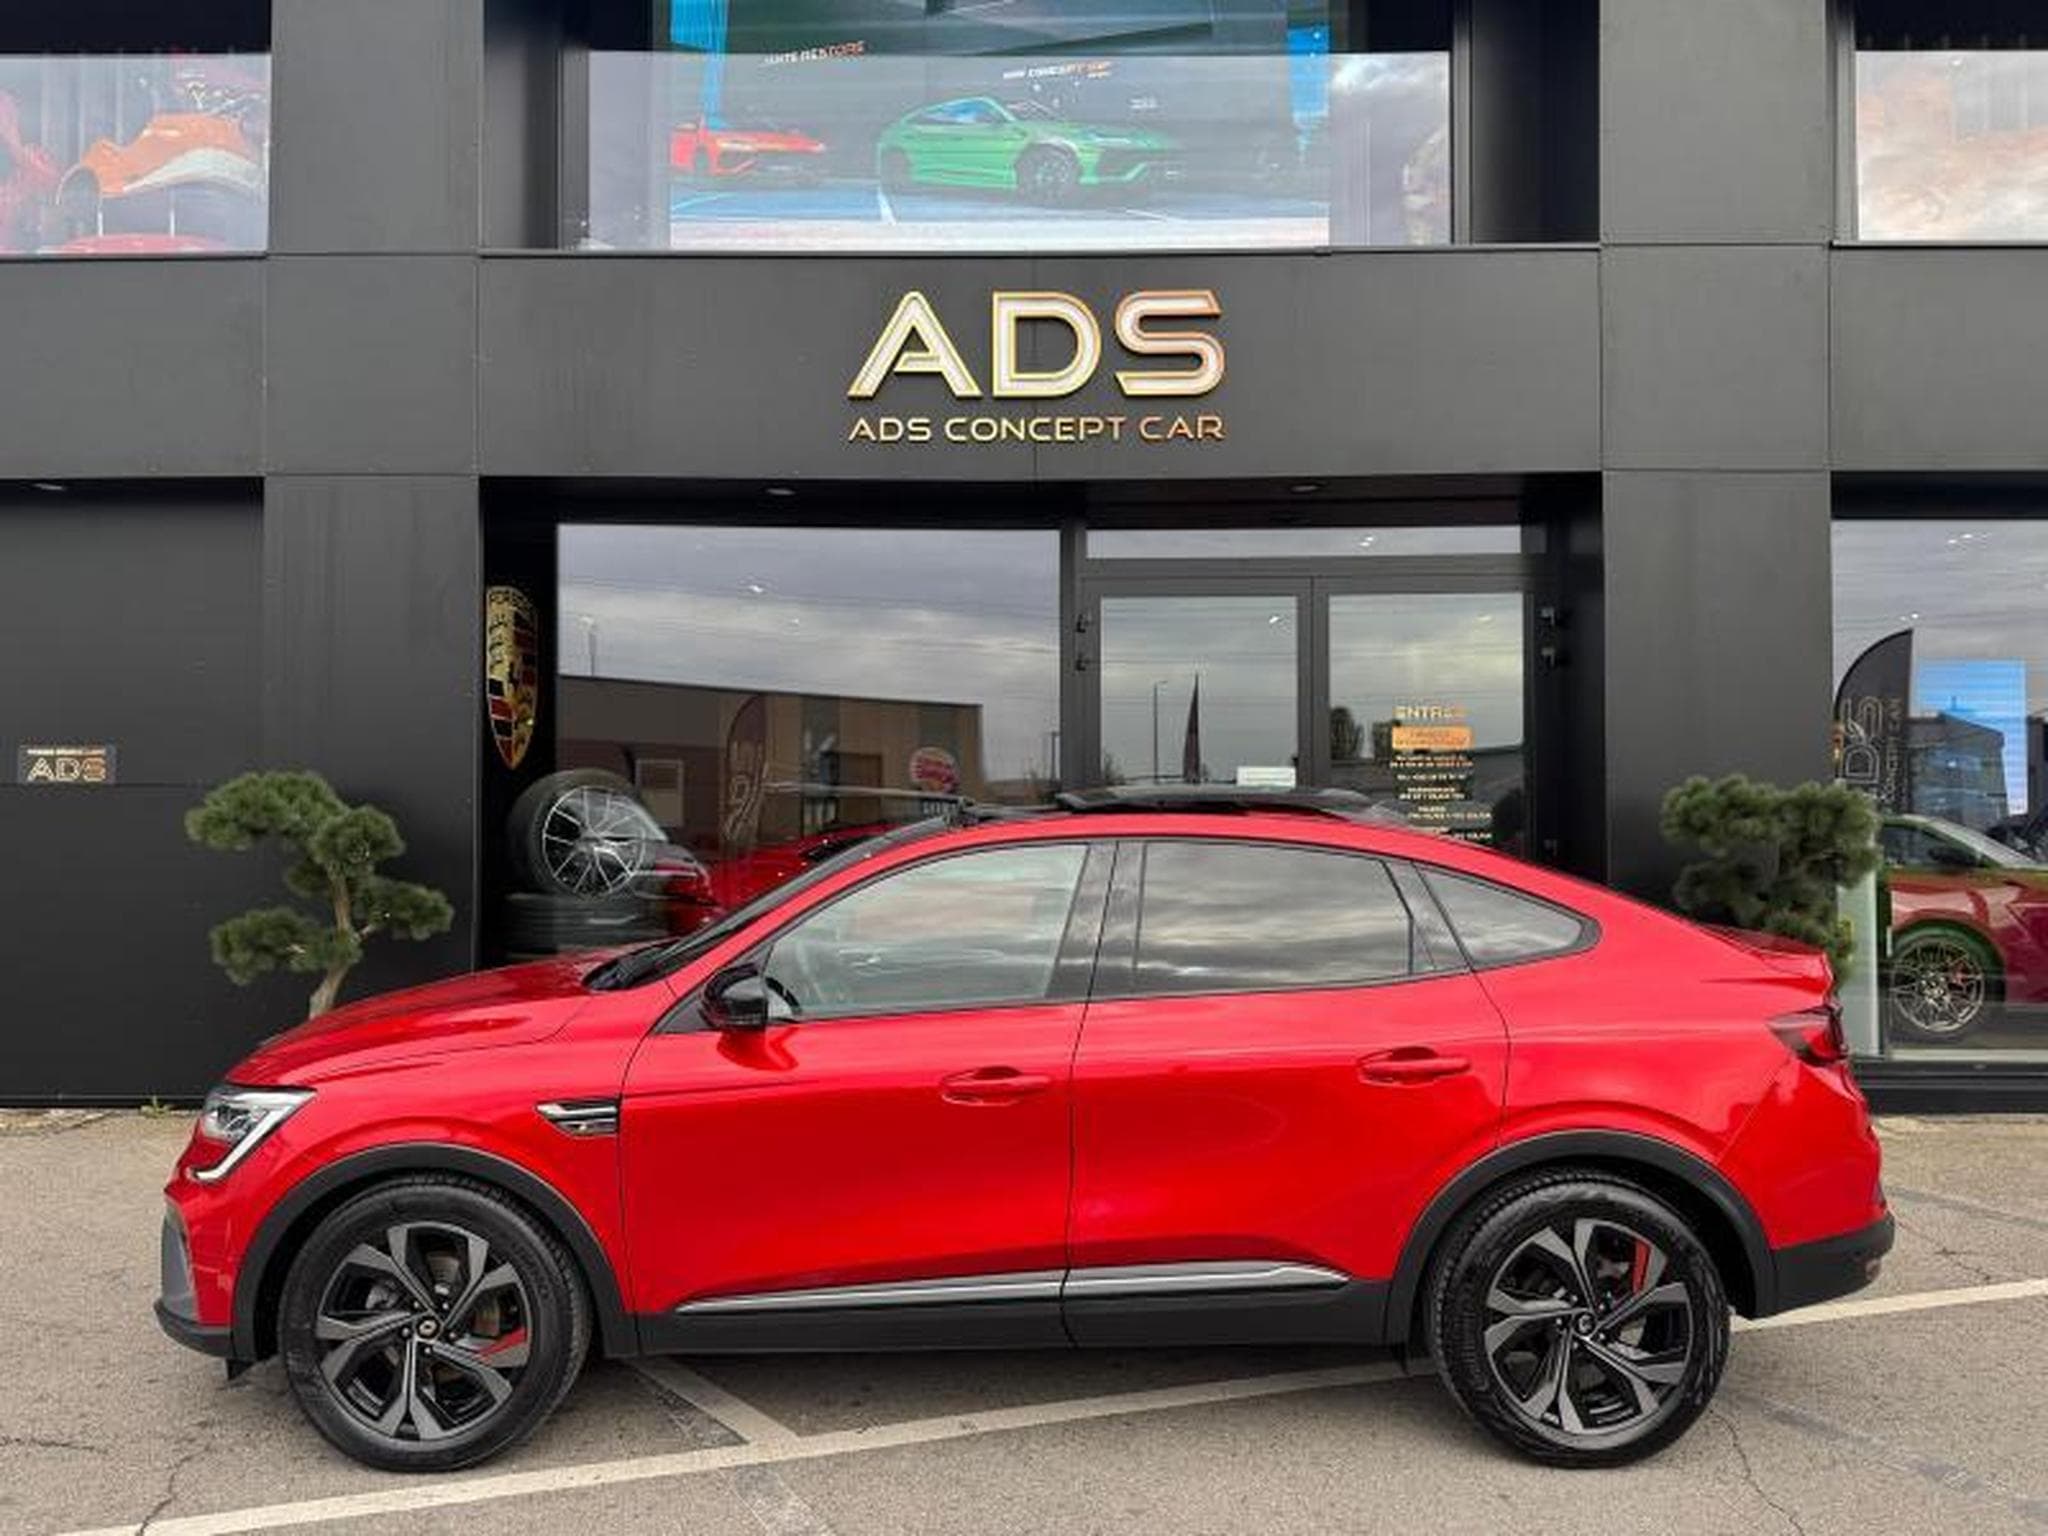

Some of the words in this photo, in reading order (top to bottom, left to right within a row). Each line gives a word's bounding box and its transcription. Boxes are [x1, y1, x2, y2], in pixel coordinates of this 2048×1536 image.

[847, 290, 1226, 399] ADS
[848, 417, 932, 442] ADS
[944, 417, 1127, 442] CONCEPT
[1139, 415, 1225, 440] CAR
[27, 757, 106, 781] ADS
